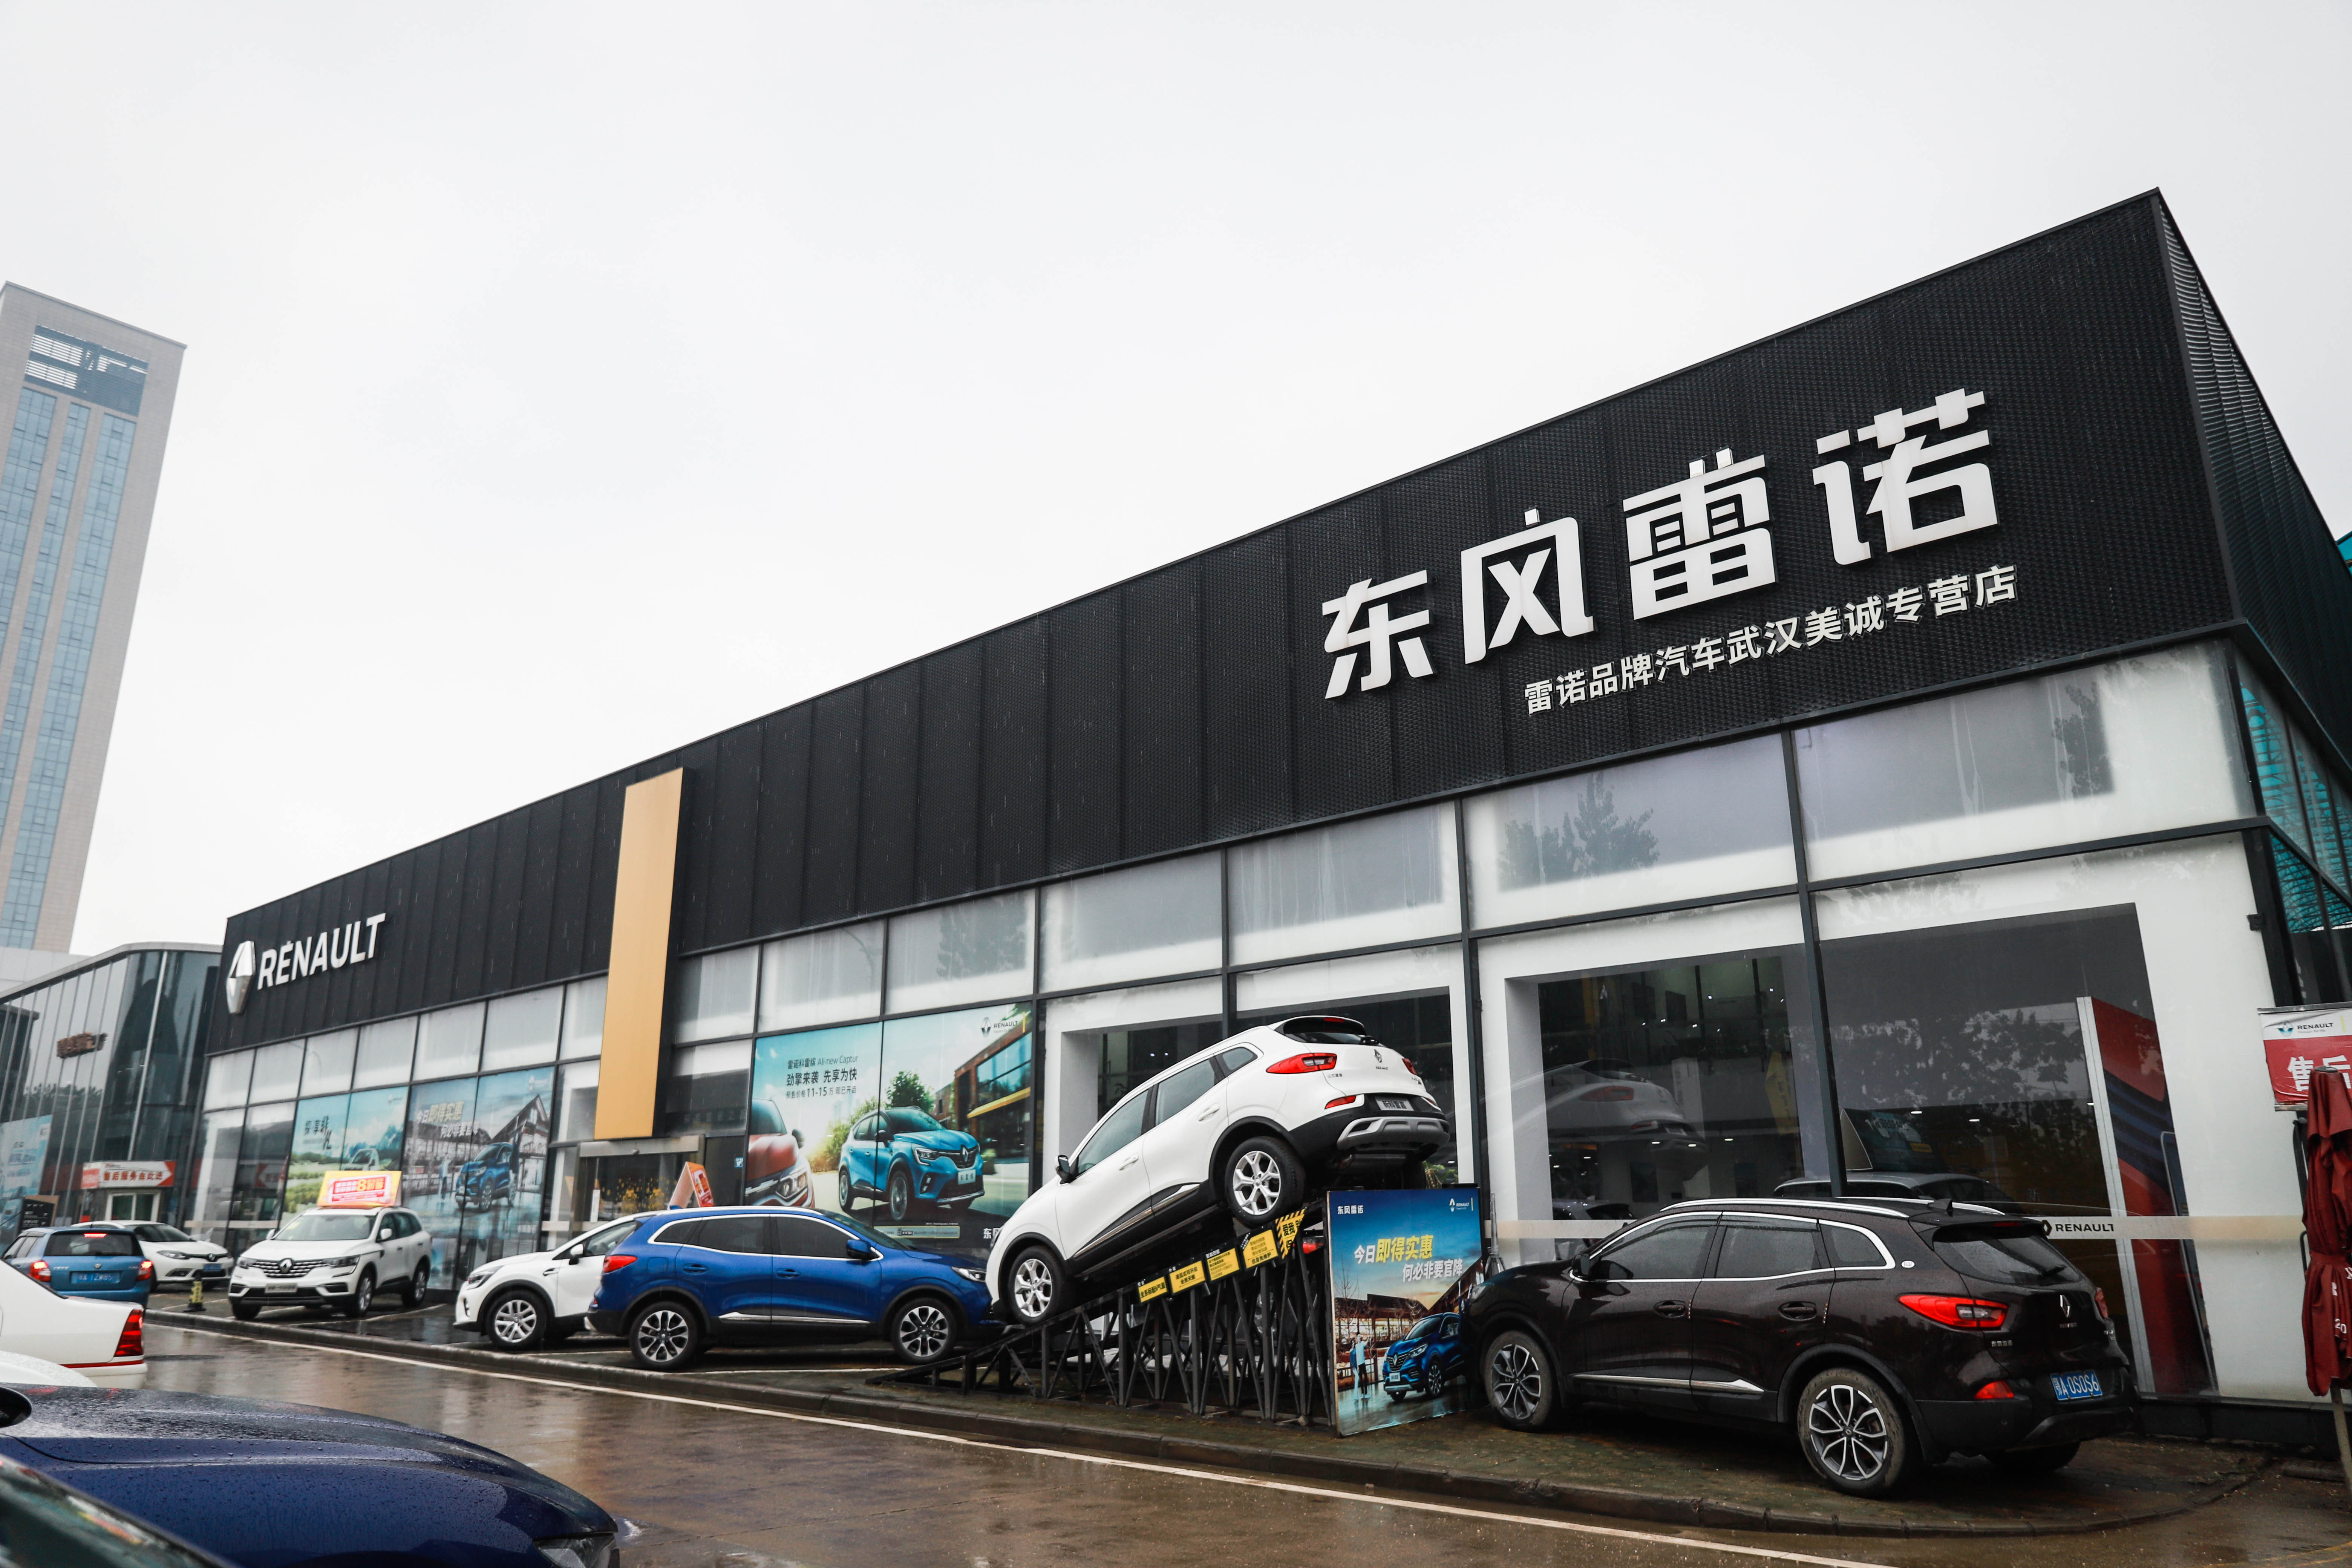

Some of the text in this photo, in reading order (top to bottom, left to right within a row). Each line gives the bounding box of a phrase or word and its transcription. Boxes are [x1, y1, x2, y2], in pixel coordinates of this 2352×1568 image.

[1322, 388, 2000, 700] 东风雷诺
[1524, 565, 2019, 715] 雷诺品牌汽车武汉美诚专营店
[257, 913, 386, 991] RENAULT
[818, 1057, 838, 1066] All-new
[839, 1055, 859, 1064] Captur
[824, 1066, 857, 1083] 先享为快
[1338, 1205, 1364, 1214] 东风雷诺
[2055, 1223, 2114, 1232] RENAULT
[1354, 1234, 1434, 1263] 今日即得实惠
[1402, 1258, 1463, 1282] 何必非要官降
